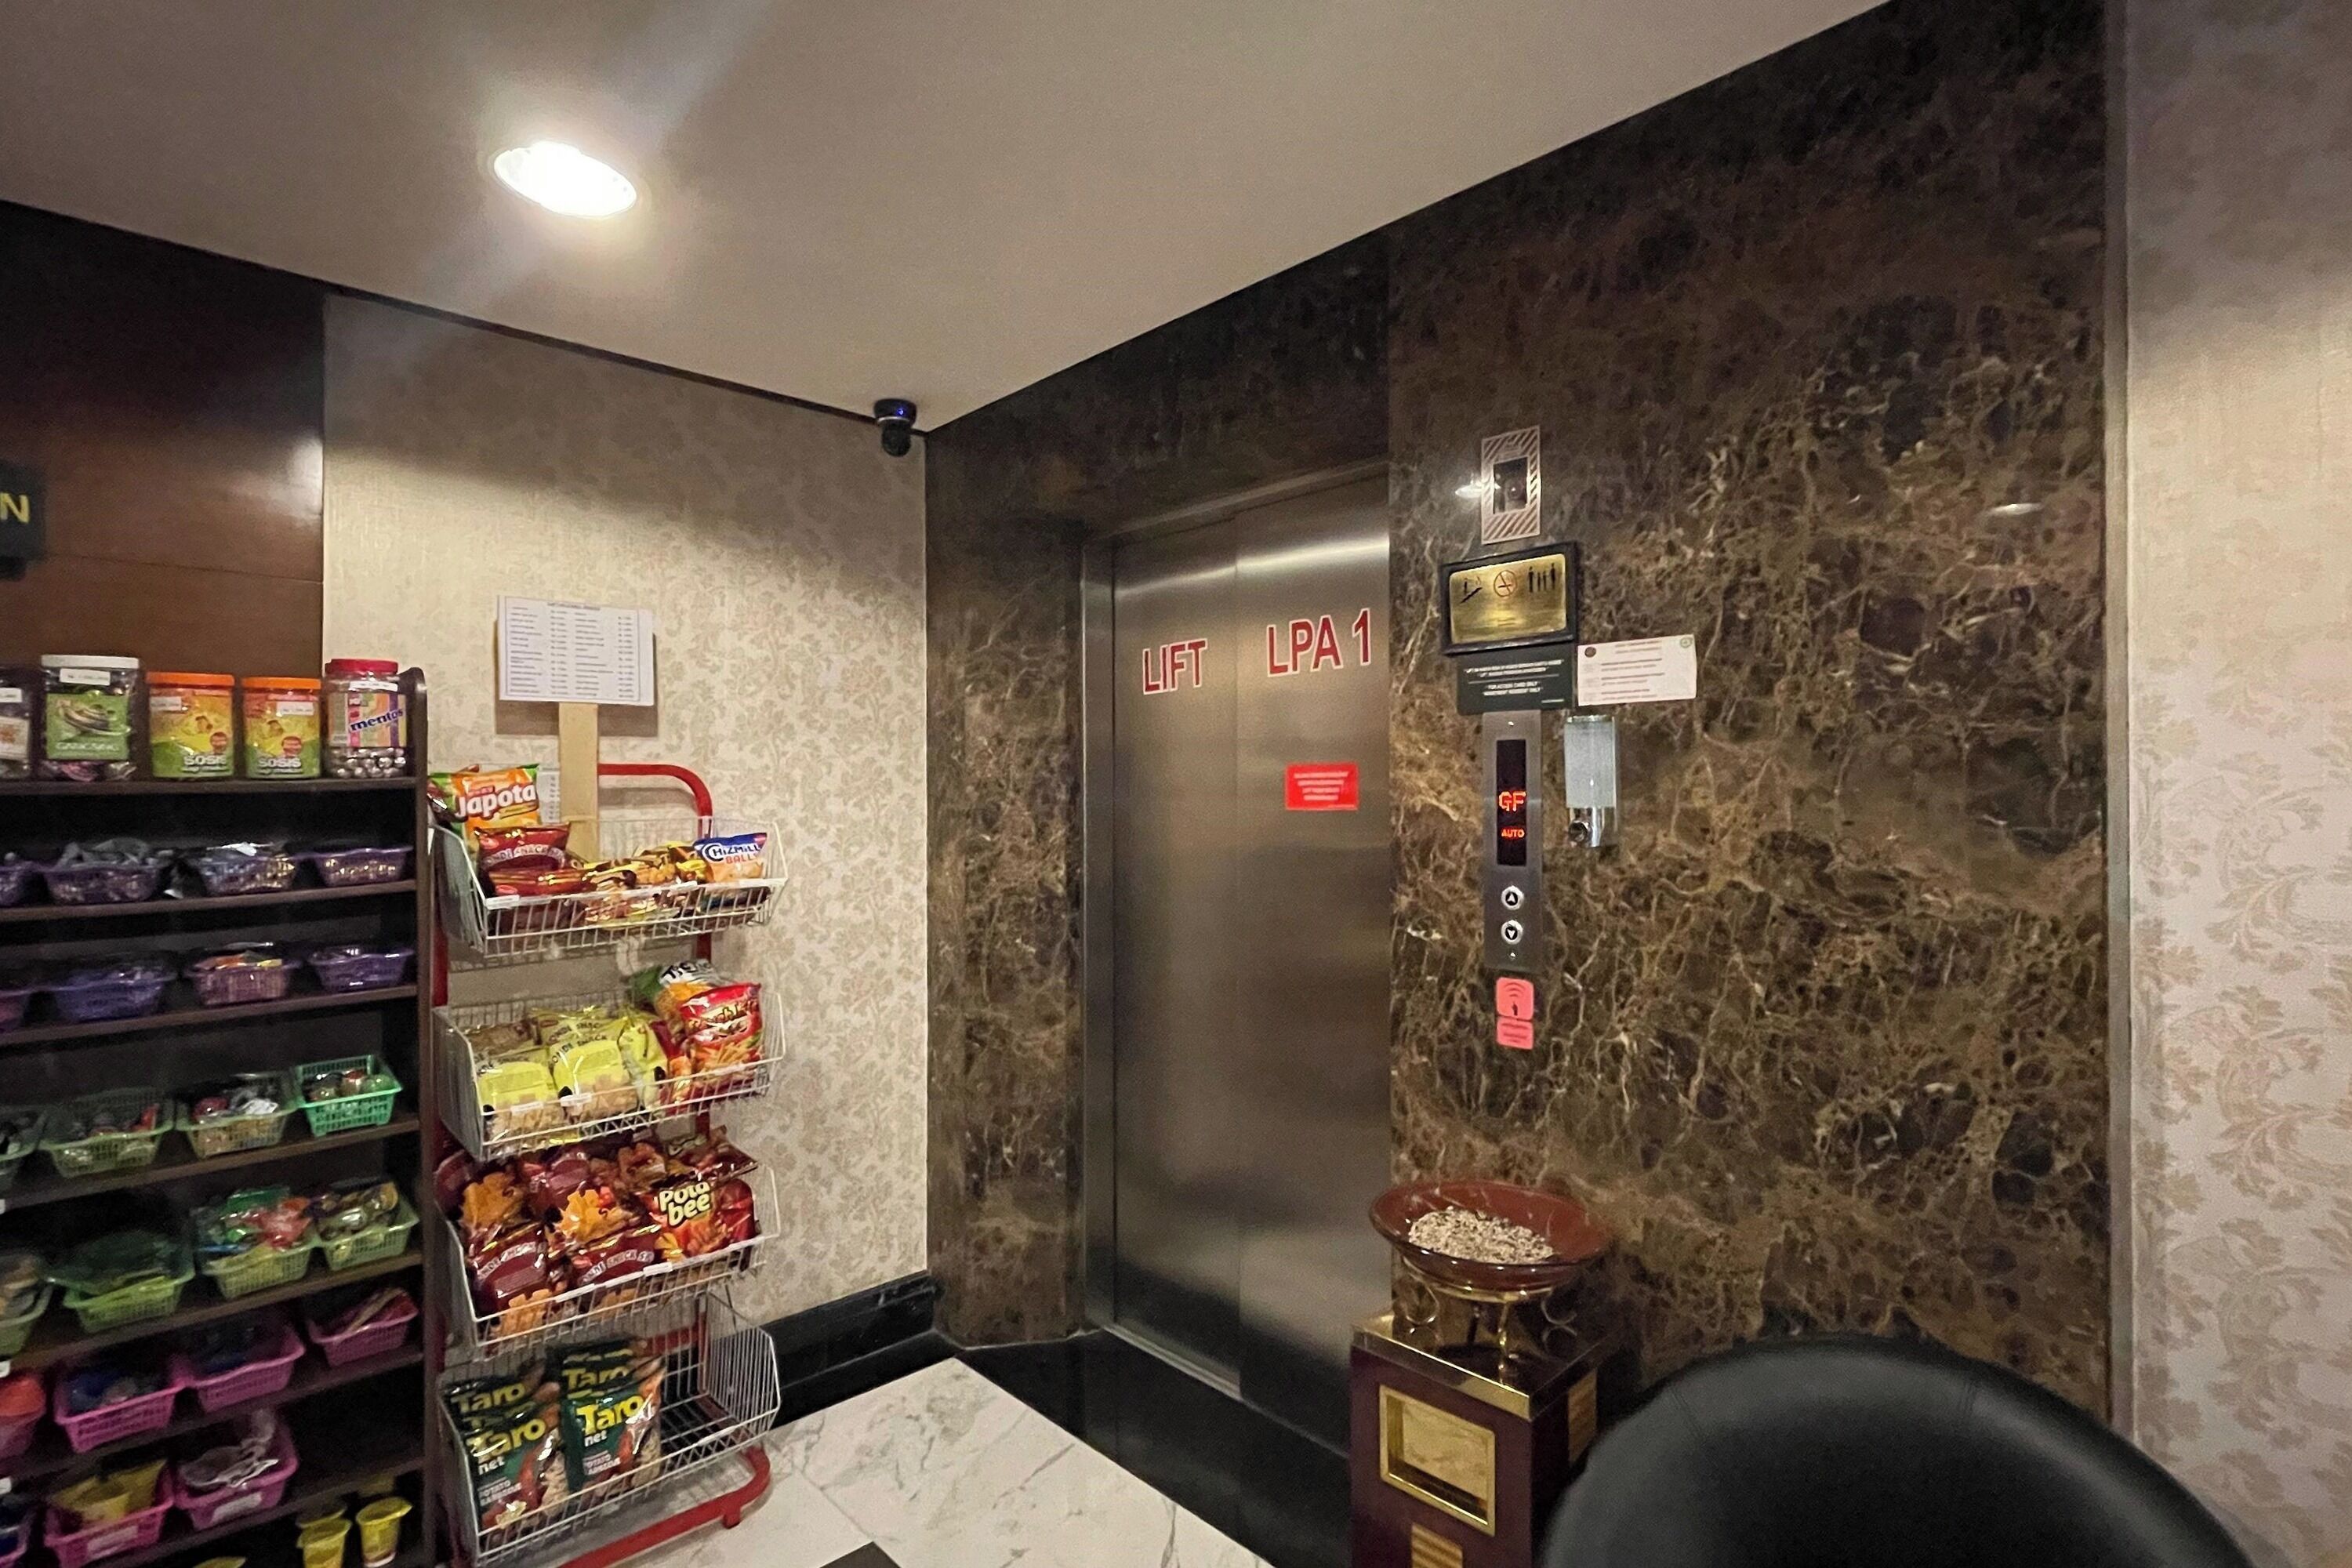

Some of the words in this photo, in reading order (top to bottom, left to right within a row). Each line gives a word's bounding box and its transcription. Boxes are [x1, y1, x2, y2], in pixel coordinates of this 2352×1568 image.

[1267, 615, 1344, 677] LPA
[1352, 608, 1370, 666] 1
[1142, 638, 1207, 695] LIFT
[350, 709, 404, 732] mentos
[456, 785, 536, 818] Japota
[1499, 791, 1526, 811] GF
[1501, 829, 1525, 838] AUTO
[668, 1194, 710, 1226] bee
[450, 1383, 525, 1413] Taro
[576, 1396, 644, 1436] Taro
[466, 1419, 546, 1464] Taro
[585, 1430, 607, 1446] net
[478, 1457, 505, 1475] net
